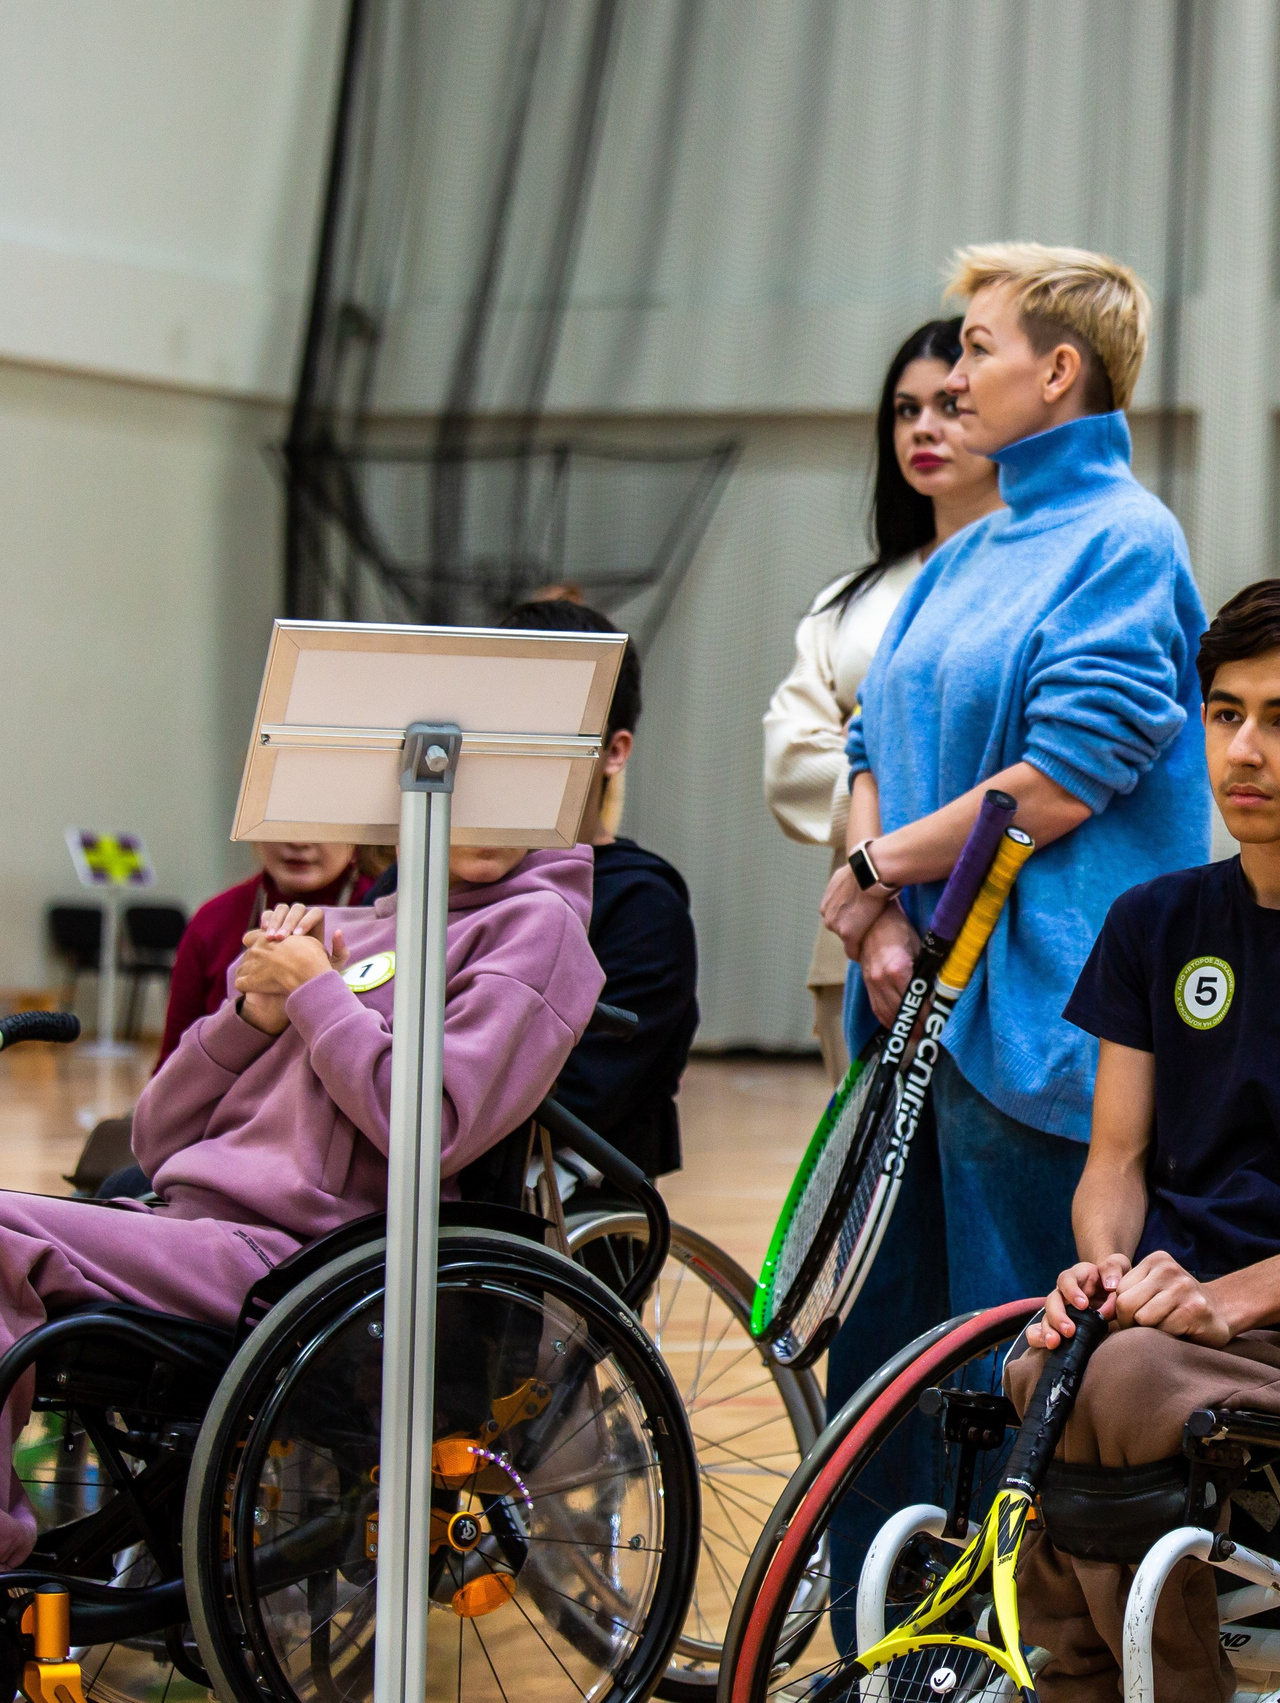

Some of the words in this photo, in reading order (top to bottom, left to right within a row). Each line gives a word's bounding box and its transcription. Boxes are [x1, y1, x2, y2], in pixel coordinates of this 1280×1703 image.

[359, 963, 374, 978] 1
[1194, 976, 1218, 1006] 5
[881, 978, 928, 1065] TORNEO
